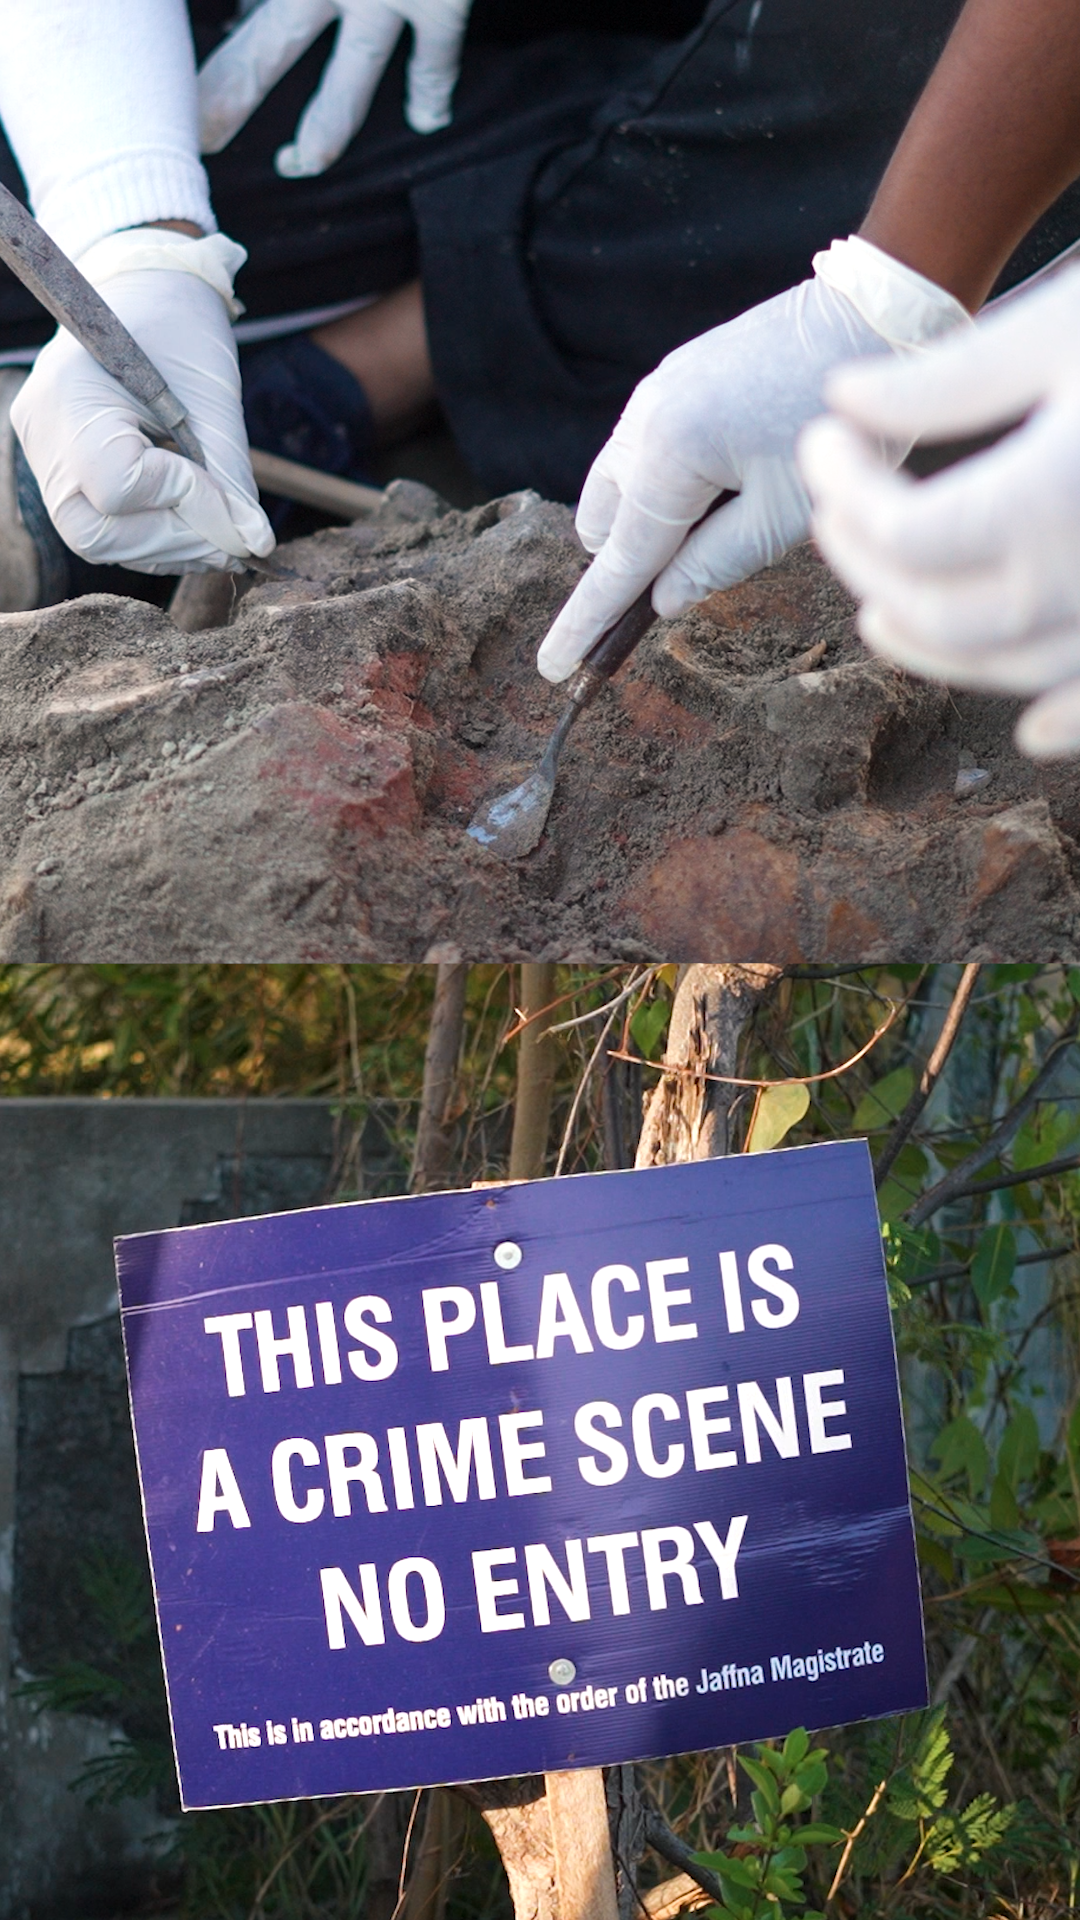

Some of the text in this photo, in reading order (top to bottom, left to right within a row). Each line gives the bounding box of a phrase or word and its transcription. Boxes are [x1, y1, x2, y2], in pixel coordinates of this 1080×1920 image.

[203, 1243, 800, 1398] THIS PLACE IS
[196, 1369, 853, 1533] A CRIME SCENE
[319, 1514, 749, 1650] NO ENTRY
[213, 1641, 885, 1750] This is in accordance with the order of the Jaffna Magistrate
